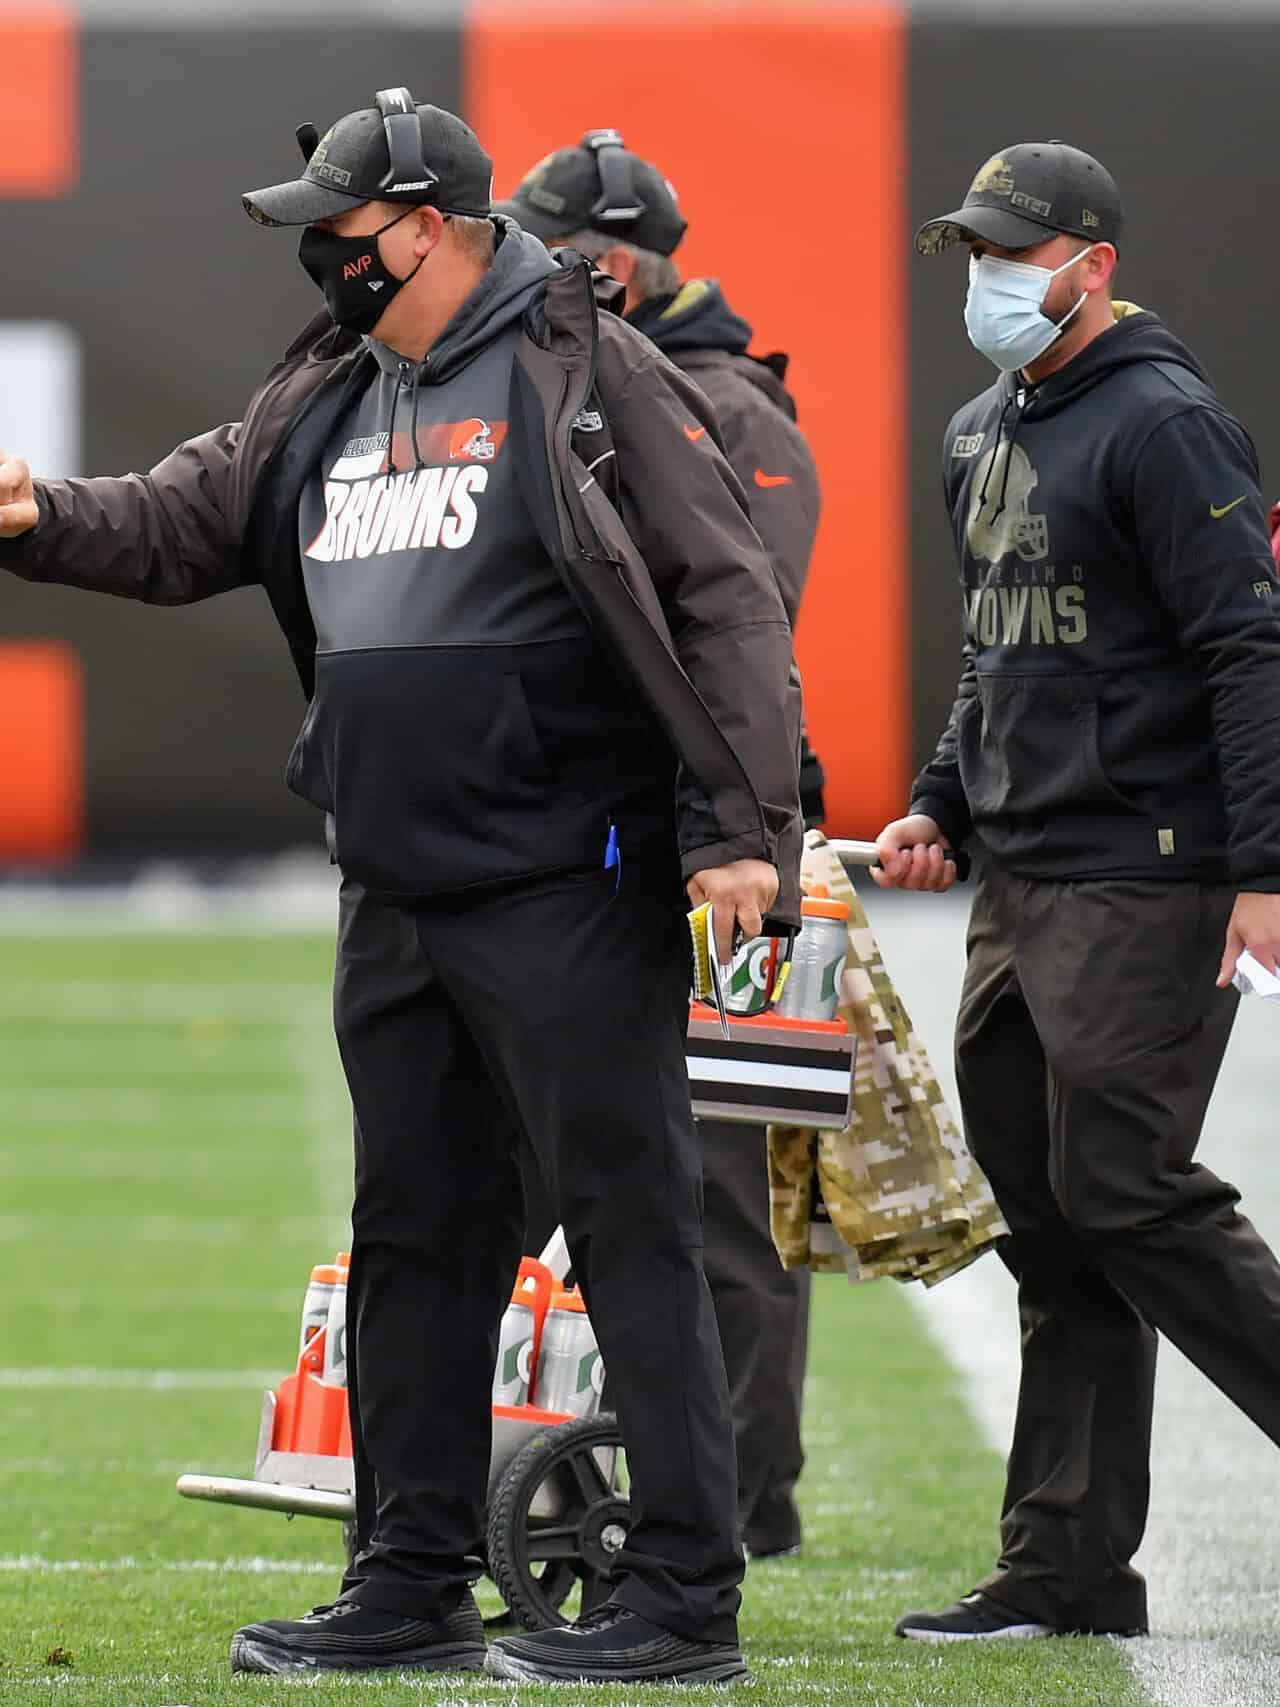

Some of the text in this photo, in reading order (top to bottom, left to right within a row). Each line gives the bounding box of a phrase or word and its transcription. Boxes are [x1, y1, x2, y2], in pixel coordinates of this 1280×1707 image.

[385, 180, 434, 192] BOSE
[343, 254, 372, 281] AVP
[304, 465, 488, 562] BROWNS
